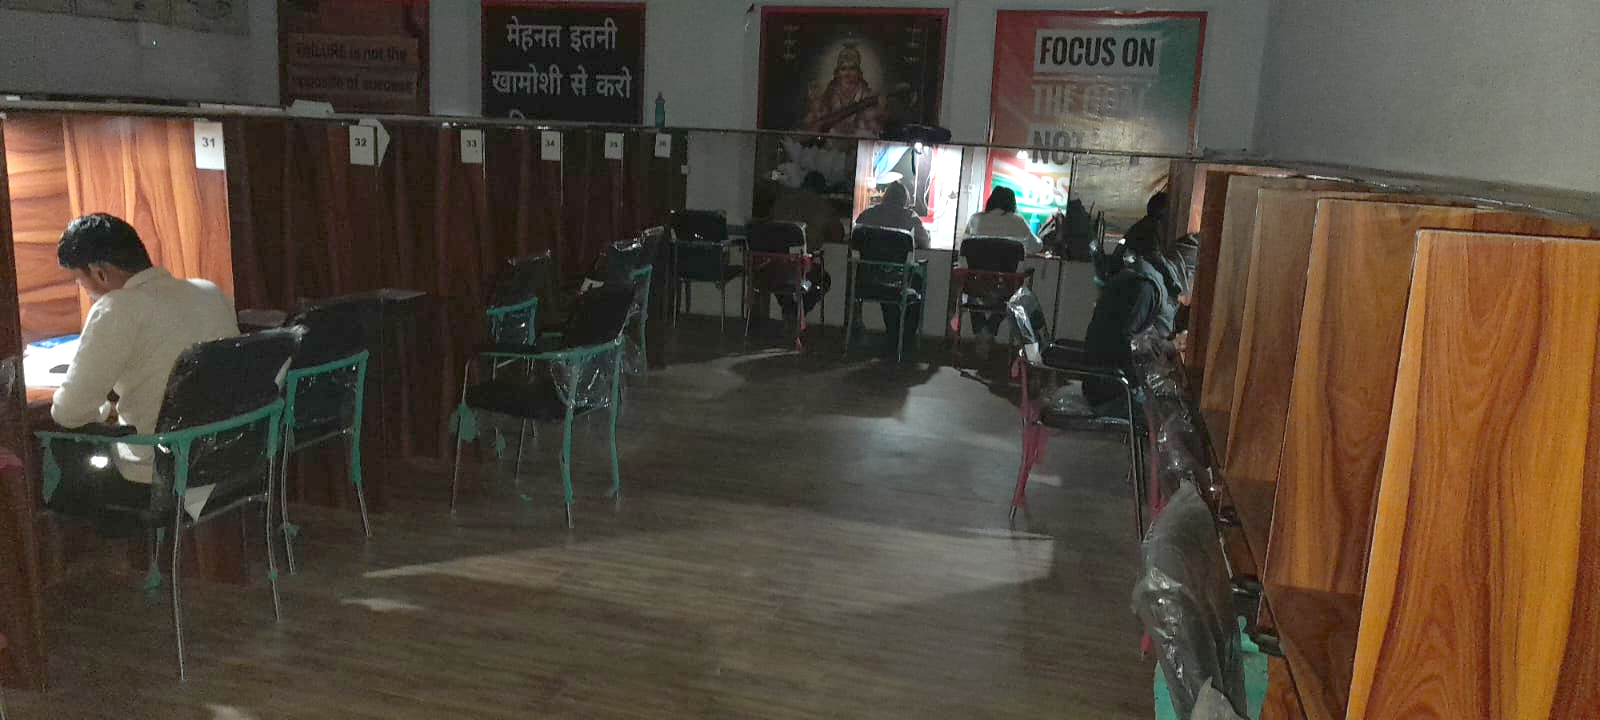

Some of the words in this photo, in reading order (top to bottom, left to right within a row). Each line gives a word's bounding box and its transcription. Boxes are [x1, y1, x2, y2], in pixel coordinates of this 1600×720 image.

[506, 15, 562, 52] मेहनत
[568, 17, 618, 52] इतनी
[362, 46, 384, 61] not
[1039, 36, 1116, 66] FOCUS
[1122, 37, 1156, 67] ON
[491, 64, 563, 96] खामोशी
[569, 64, 589, 96] से
[595, 65, 632, 99] करो
[202, 137, 215, 148] 31
[354, 138, 367, 147] 32
[466, 140, 477, 148] 33
[545, 139, 555, 147] 34
